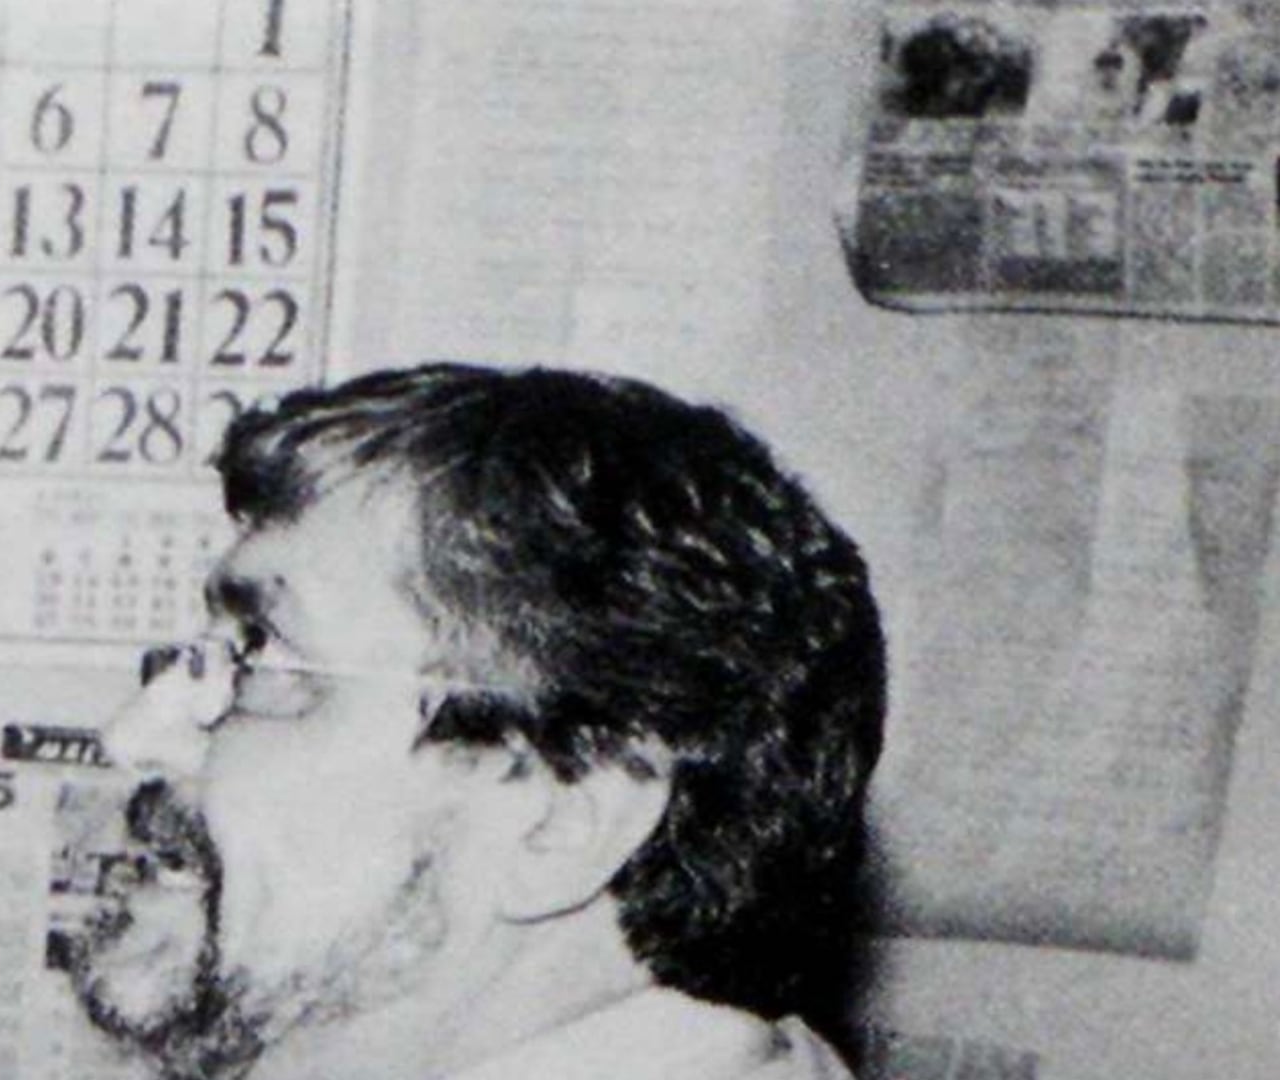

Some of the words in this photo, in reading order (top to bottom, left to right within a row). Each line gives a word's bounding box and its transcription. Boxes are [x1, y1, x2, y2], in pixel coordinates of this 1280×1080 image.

[257, 0, 285, 57] 1
[30, 83, 74, 154] 6
[141, 81, 181, 160] 7
[244, 84, 288, 163] 8
[10, 183, 85, 258] 13
[118, 187, 188, 260] 14
[227, 190, 298, 267] 15
[1, 284, 85, 361] 20
[107, 283, 182, 363] 21
[210, 289, 299, 367] 22
[97, 387, 184, 463] 28
